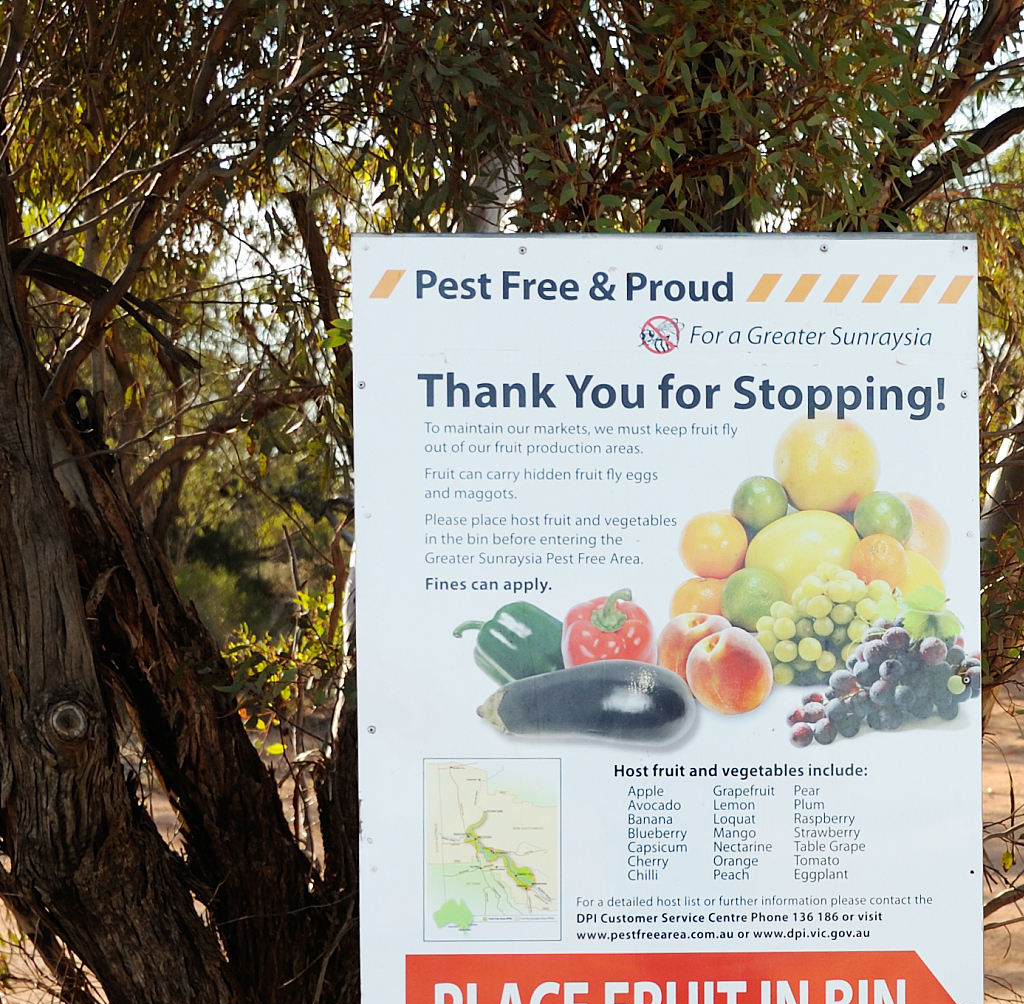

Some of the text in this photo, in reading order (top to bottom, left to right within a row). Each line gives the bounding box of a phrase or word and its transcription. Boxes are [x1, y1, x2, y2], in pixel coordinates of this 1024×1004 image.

[416, 270, 733, 302] Pest Free & Proud
[690, 326, 931, 350] For a Greater Sunraysia
[418, 372, 945, 420] Thank You for Stopping!
[424, 422, 737, 438] To maintain our markets, we must keep fruit fly
[425, 441, 643, 455] out of our fruit production areas.
[425, 468, 658, 483] Fruit can carry hidden fruit fly eggs
[425, 487, 517, 502] and maggots.
[426, 514, 677, 529] Please place host fruit and vegetables
[425, 533, 622, 548] in the bin before entering the
[425, 552, 643, 567] Greater Sunraysia Pest Free Area.
[426, 578, 551, 593] Fines can apply.
[615, 764, 867, 780] Host fruit and vegetables include:
[628, 786, 664, 799] Apple
[713, 786, 774, 799] Grapefruit
[794, 786, 820, 796] Pear
[628, 800, 681, 810] Avocado
[714, 800, 755, 810] Lemon
[795, 800, 824, 810] Plum
[629, 814, 672, 824] Banana
[714, 814, 755, 827] Loquat
[795, 813, 855, 828] Raspberry
[628, 827, 687, 841] Blueberry
[714, 827, 756, 841] Mango
[794, 827, 860, 842] Strawberry
[628, 842, 687, 855] Capsicum
[714, 842, 772, 852] Nectarine
[794, 841, 865, 854] Table Grape
[628, 855, 668, 869] Cherry
[714, 855, 758, 870] Orange
[794, 855, 839, 865] Tomato
[628, 869, 657, 879] Chilli
[714, 869, 749, 879] Peach
[795, 869, 848, 882] Eggplant
[577, 897, 593, 907] For
[607, 896, 652, 906] detailed
[657, 897, 680, 906] host
[685, 896, 700, 906] list
[719, 896, 757, 906] further
[762, 895, 827, 905] information
[831, 895, 866, 907] please
[870, 897, 910, 905] contact
[915, 894, 932, 904] the
[577, 914, 596, 923] DPI
[601, 914, 658, 923] Customer
[662, 913, 704, 922] Service
[709, 913, 747, 922] Centre
[752, 912, 788, 922] Phone
[794, 913, 813, 921] 136
[819, 912, 838, 921] 186
[858, 912, 882, 921] visit
[577, 929, 733, 942] www.pestfreearea.com.au
[753, 928, 869, 940] www.dpi.vic.gov.au
